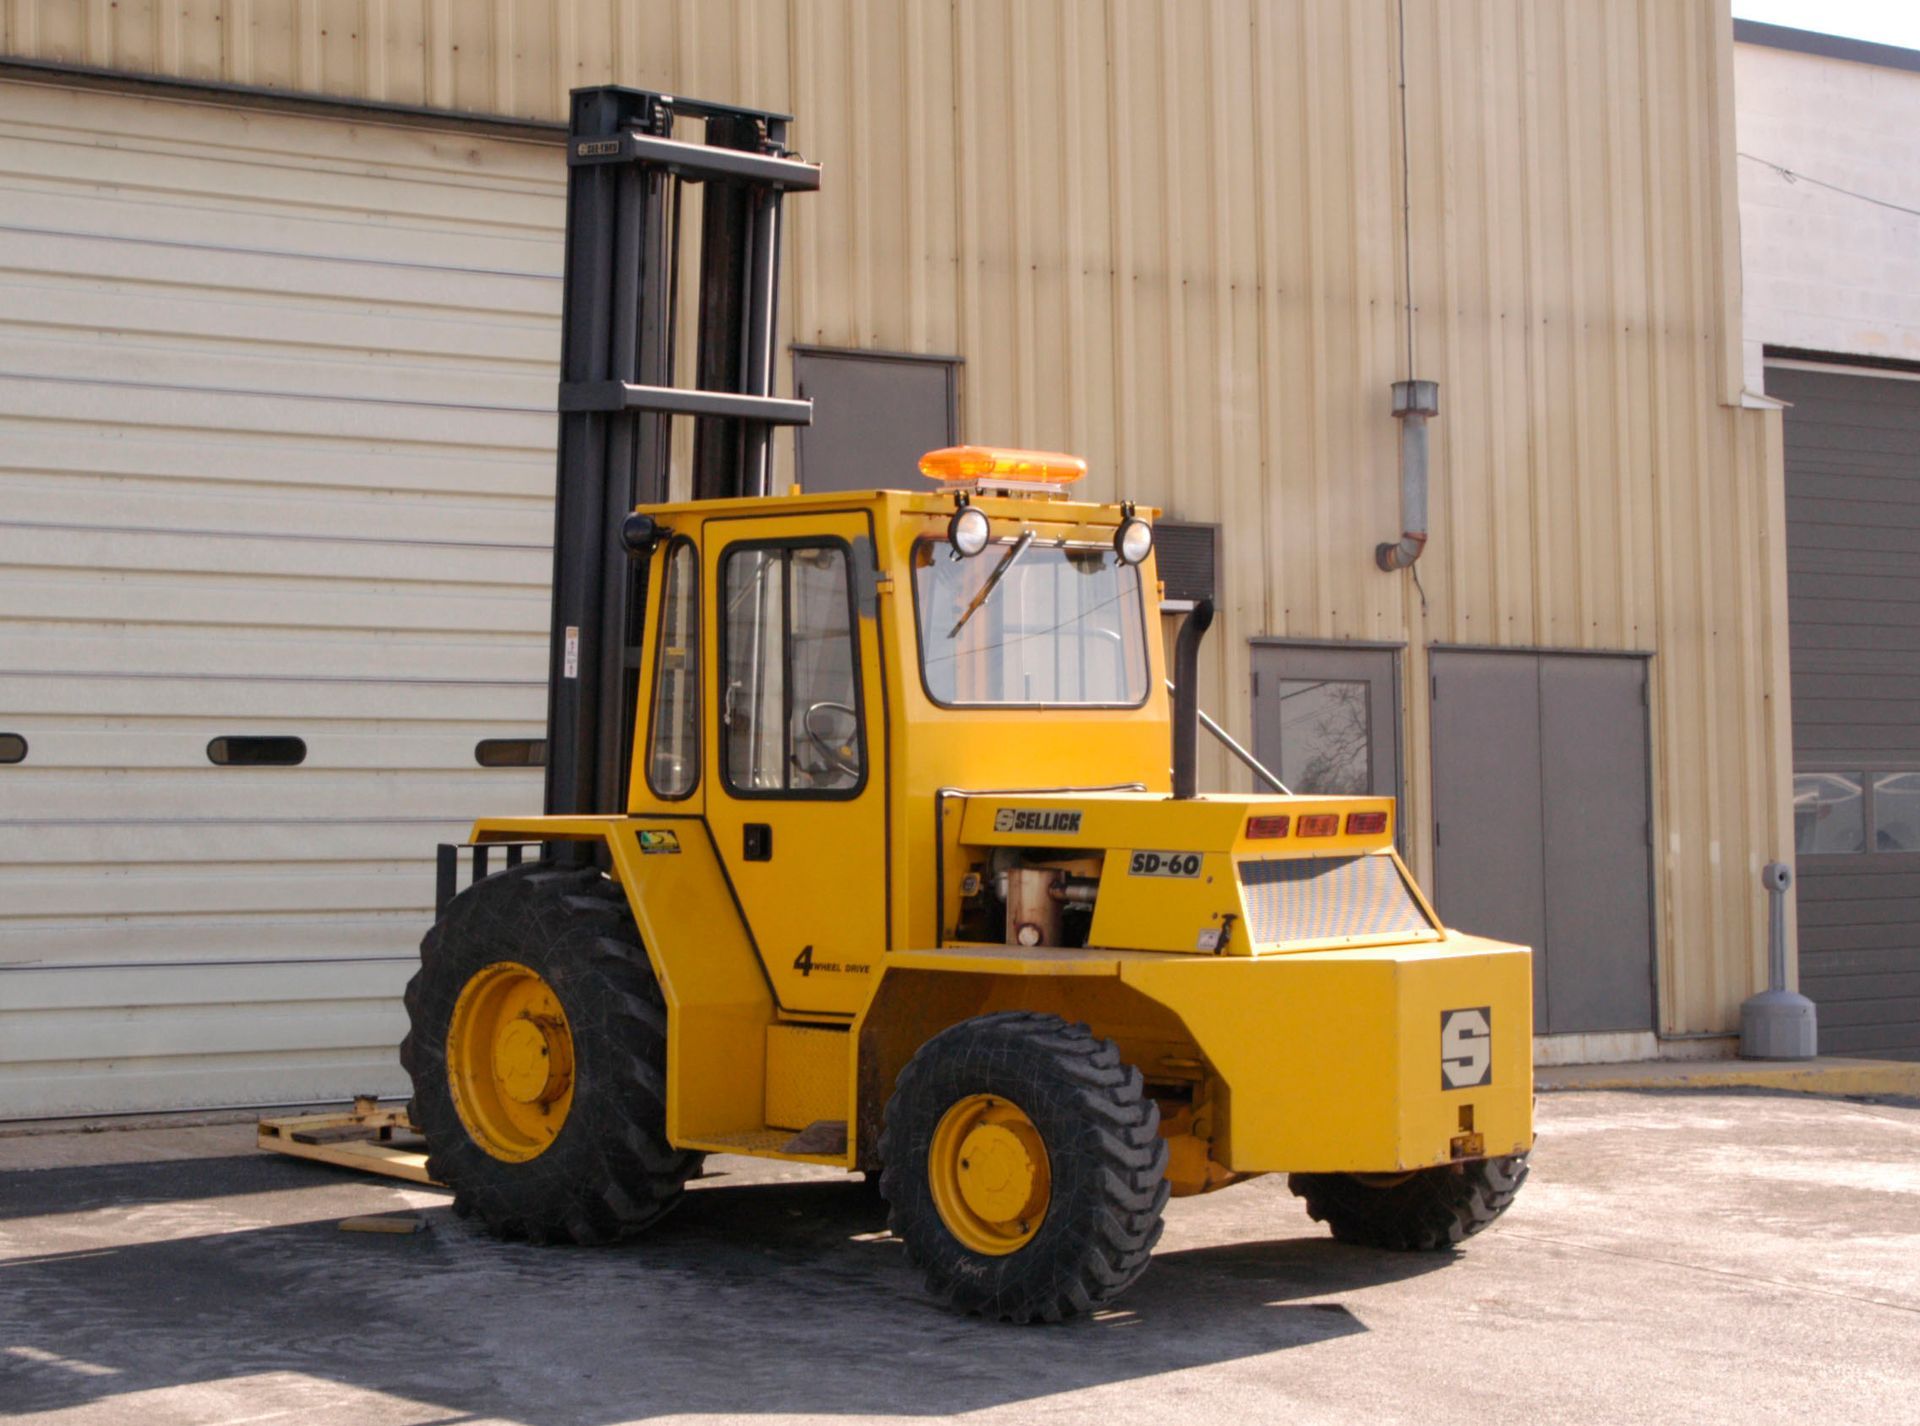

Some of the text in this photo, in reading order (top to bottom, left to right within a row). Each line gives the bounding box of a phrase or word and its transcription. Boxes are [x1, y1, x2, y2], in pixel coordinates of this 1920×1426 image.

[1015, 812, 1081, 831] SELLICK
[1131, 853, 1199, 875] SD-60
[793, 944, 870, 976] 4 WHEEL DRIVE
[1441, 1009, 1491, 1088] S
